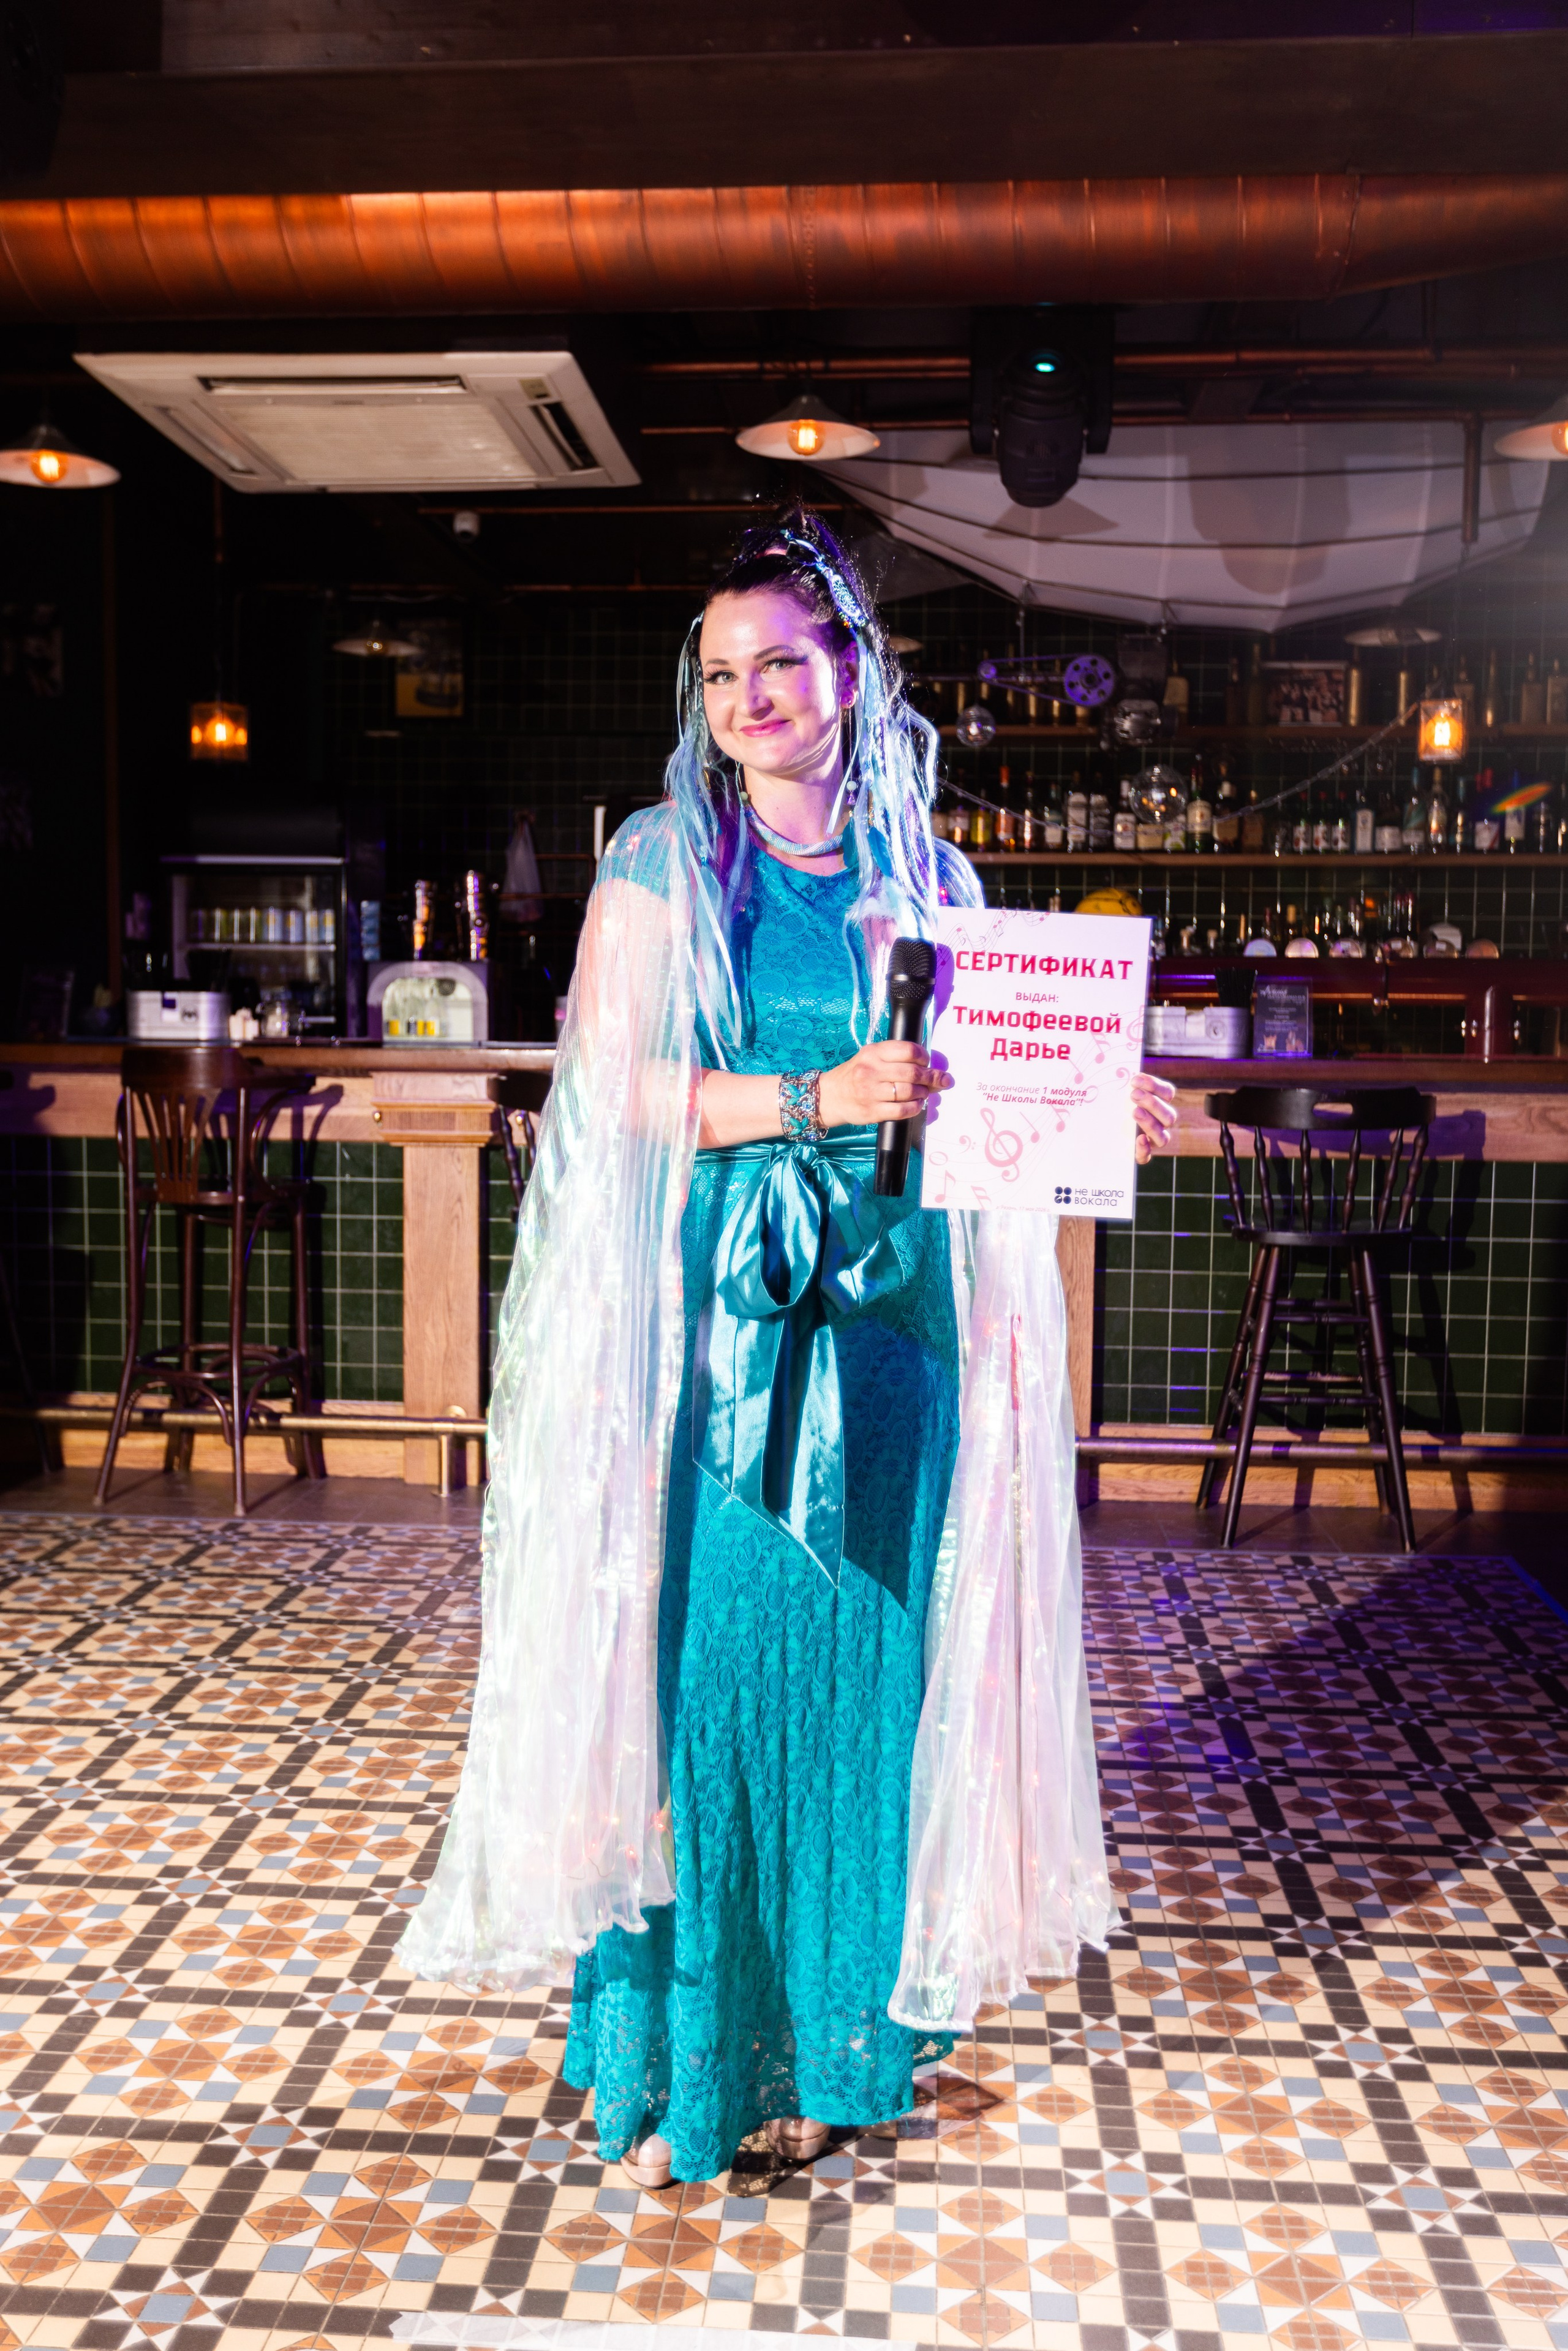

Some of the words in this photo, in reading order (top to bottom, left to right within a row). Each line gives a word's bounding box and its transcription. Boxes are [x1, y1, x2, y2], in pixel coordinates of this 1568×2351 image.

[956, 951, 1133, 979] СЕРТИФИКАТ
[953, 1006, 1122, 1033] Тимофеевой
[990, 1038, 1071, 1061] Дарье
[976, 1082, 987, 1090] За
[990, 1083, 1040, 1094] окончание
[1050, 1087, 1087, 1098] модуля
[1001, 1093, 1037, 1103] Школы
